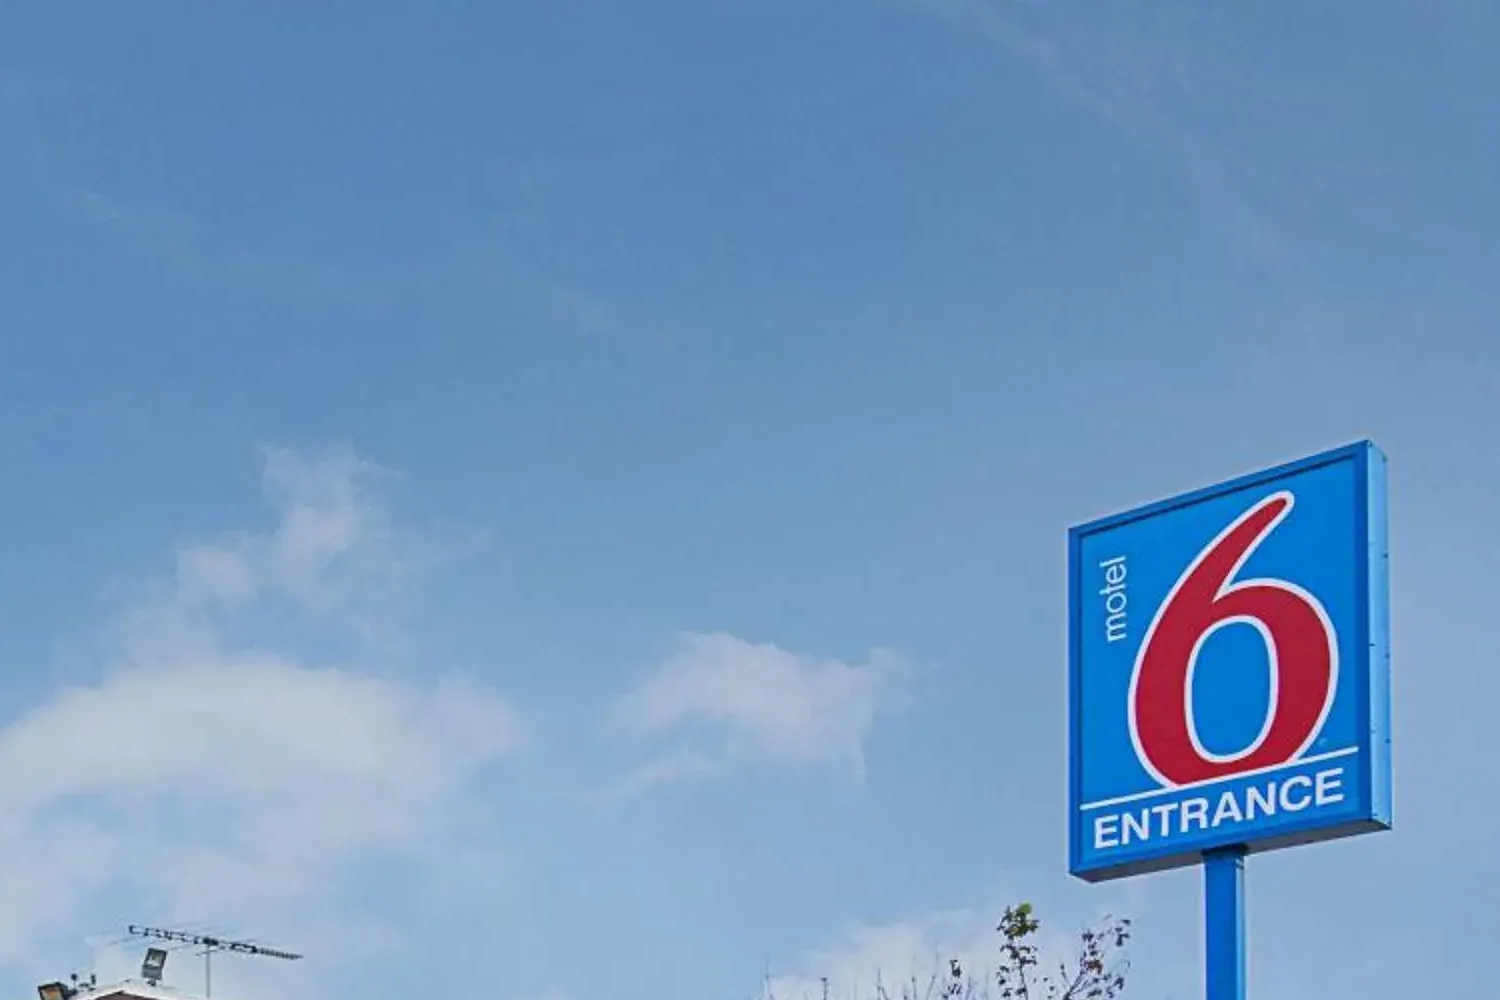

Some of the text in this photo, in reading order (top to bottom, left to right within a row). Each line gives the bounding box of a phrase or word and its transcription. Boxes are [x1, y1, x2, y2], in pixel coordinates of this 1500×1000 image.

[1100, 555, 1127, 643] motel
[1127, 490, 1339, 789] 6
[1093, 766, 1345, 849] ENTRANCE
